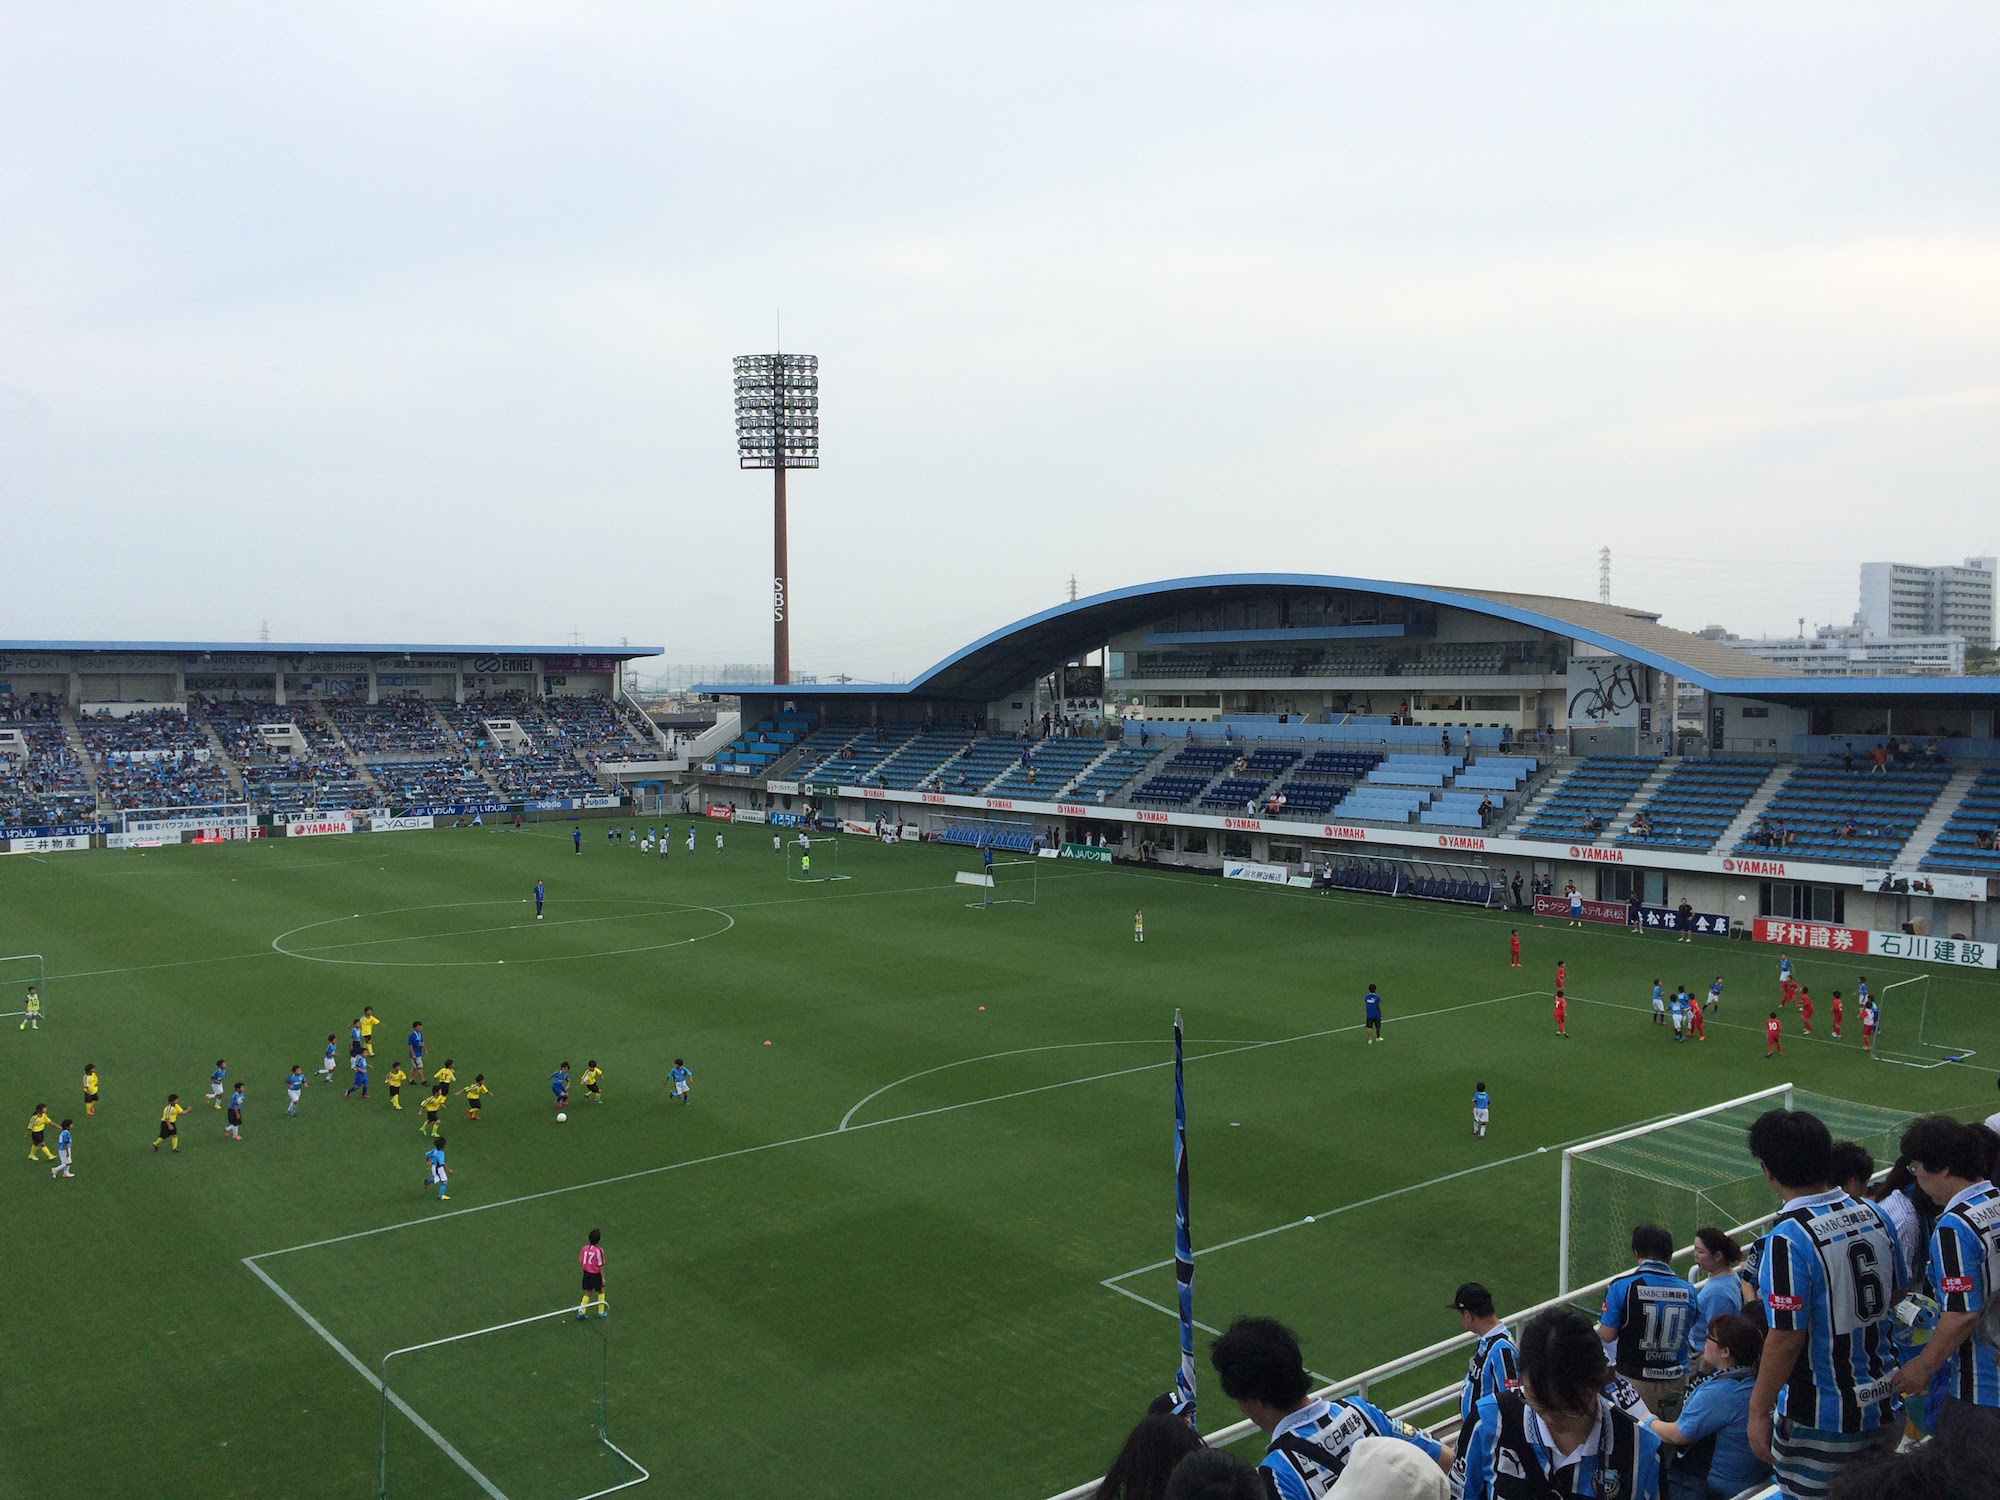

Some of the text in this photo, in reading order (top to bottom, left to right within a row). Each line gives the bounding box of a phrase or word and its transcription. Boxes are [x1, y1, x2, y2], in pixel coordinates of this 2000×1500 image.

[774, 577, 785, 622] SBS
[502, 658, 533, 672] ENKEI
[867, 789, 886, 799] YAMAHA
[927, 794, 946, 803] YAMAHA
[427, 806, 456, 815] いわしん
[991, 799, 1012, 810] YAMAHA
[1063, 806, 1086, 816] YAMAHA
[1143, 811, 1169, 823] YAMAHA
[70, 825, 106, 834] いわしん
[305, 823, 347, 834] YAMAHA
[383, 818, 421, 830] YAGI
[1232, 819, 1261, 831] YAMAHA
[1333, 827, 1366, 840] YAMAHA
[24, 838, 77, 850] 三井物産
[1448, 836, 1485, 850] YAMAHA
[1581, 847, 1624, 863] YAMAHA
[1736, 860, 1785, 876] YAMAHA
[1550, 902, 1625, 921] グランホテル浜松
[1631, 910, 1728, 935] 松信金庫
[1766, 921, 1854, 951] 野村證券
[1880, 933, 1985, 967] 石川建設
[1768, 1021, 1778, 1031] 10
[583, 1250, 595, 1265] 17
[1847, 1238, 1886, 1323] 6
[1638, 1302, 1689, 1351] 10
